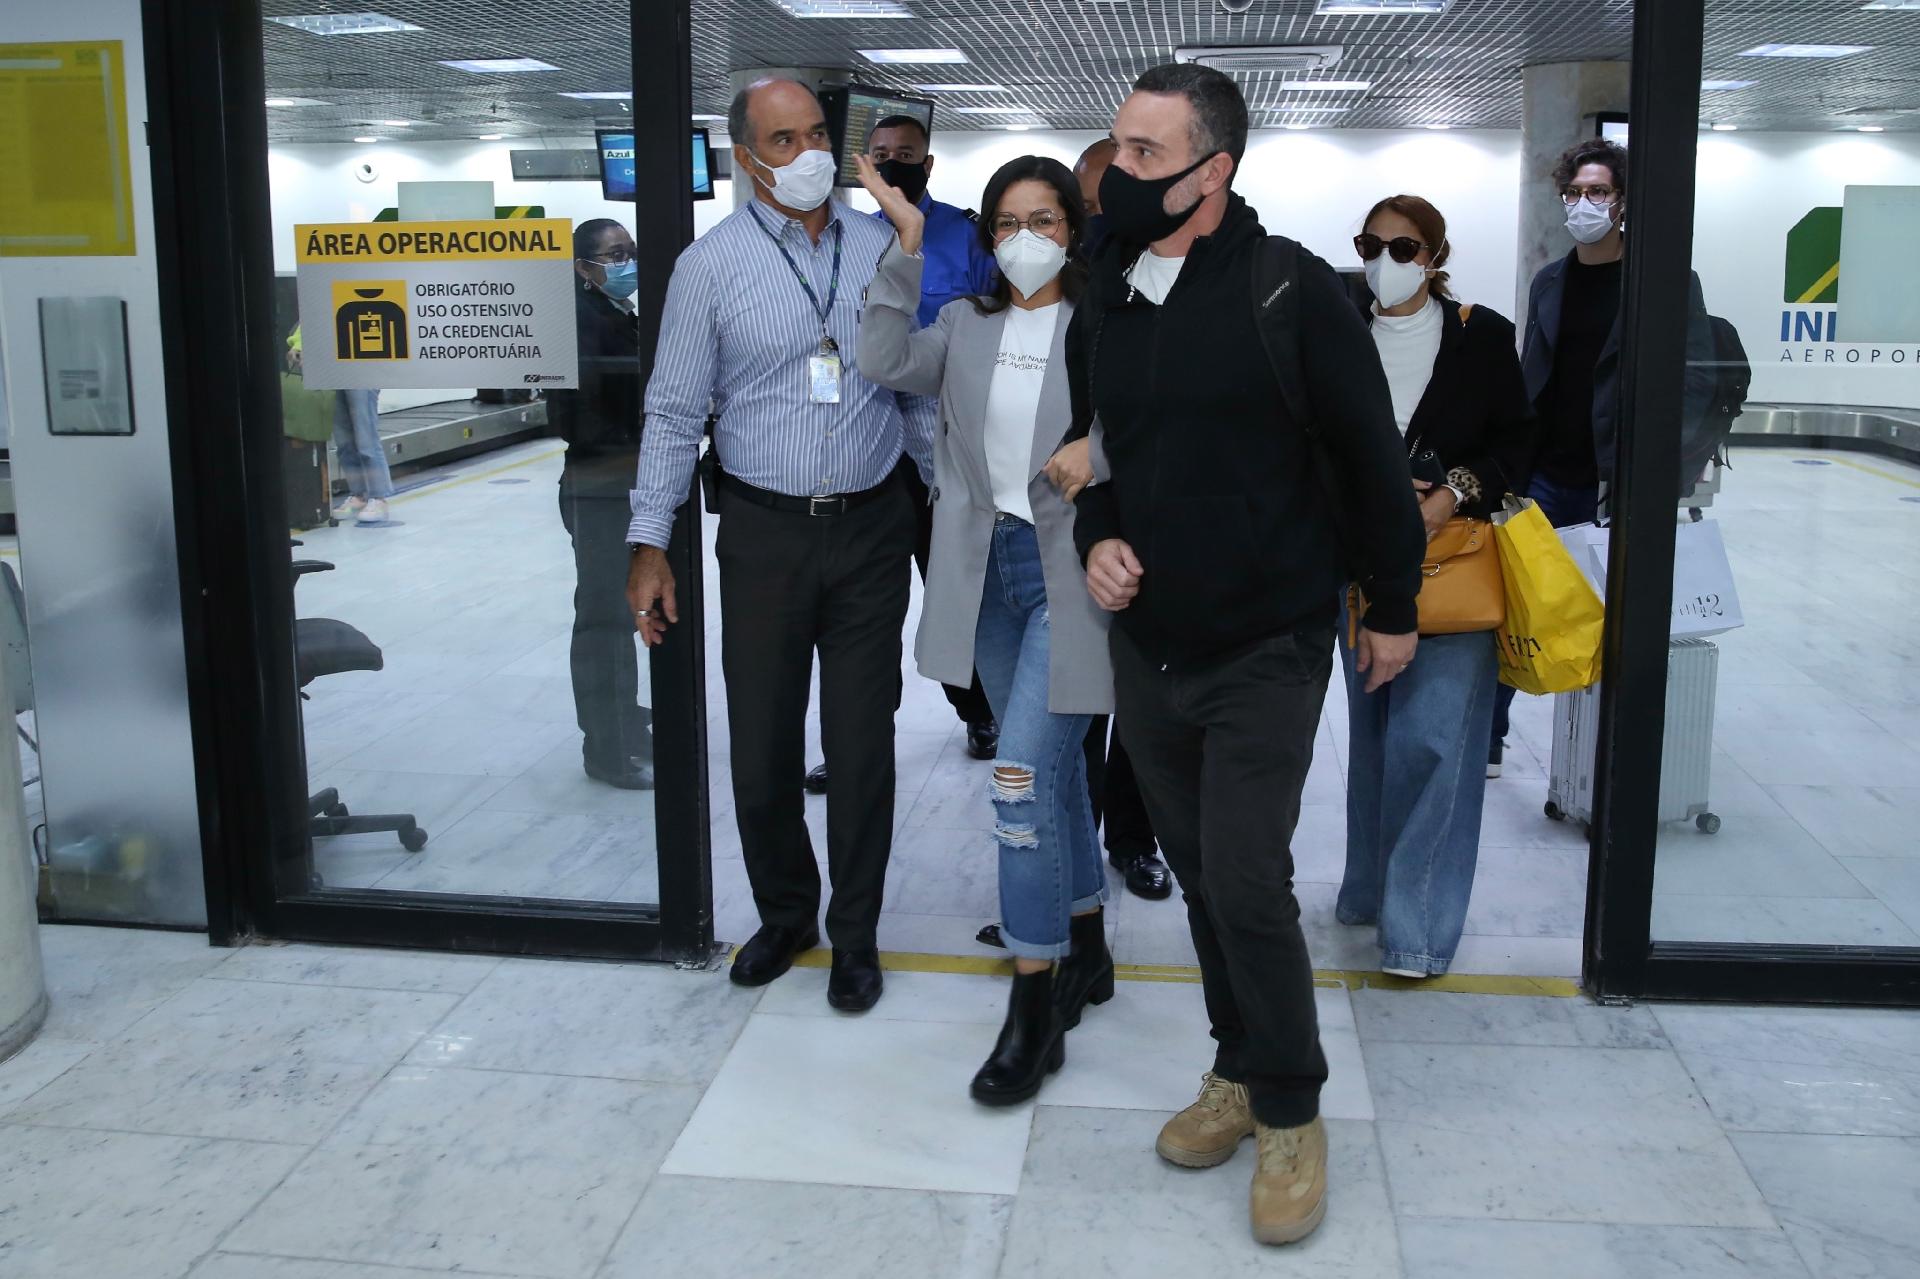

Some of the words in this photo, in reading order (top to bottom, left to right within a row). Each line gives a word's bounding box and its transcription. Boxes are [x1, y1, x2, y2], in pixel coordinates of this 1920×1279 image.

[607, 150, 630, 158] Azul
[306, 229, 372, 256] ÁREA
[377, 230, 561, 254] OPERACIONAL
[415, 281, 515, 297] OBRIGATÓRIO
[417, 304, 447, 318] USO
[450, 304, 534, 317] OSTENSIVO
[418, 325, 439, 339] DA
[442, 324, 533, 338] CREDENCIAL
[419, 344, 542, 359] AEROPORTUÁRIA
